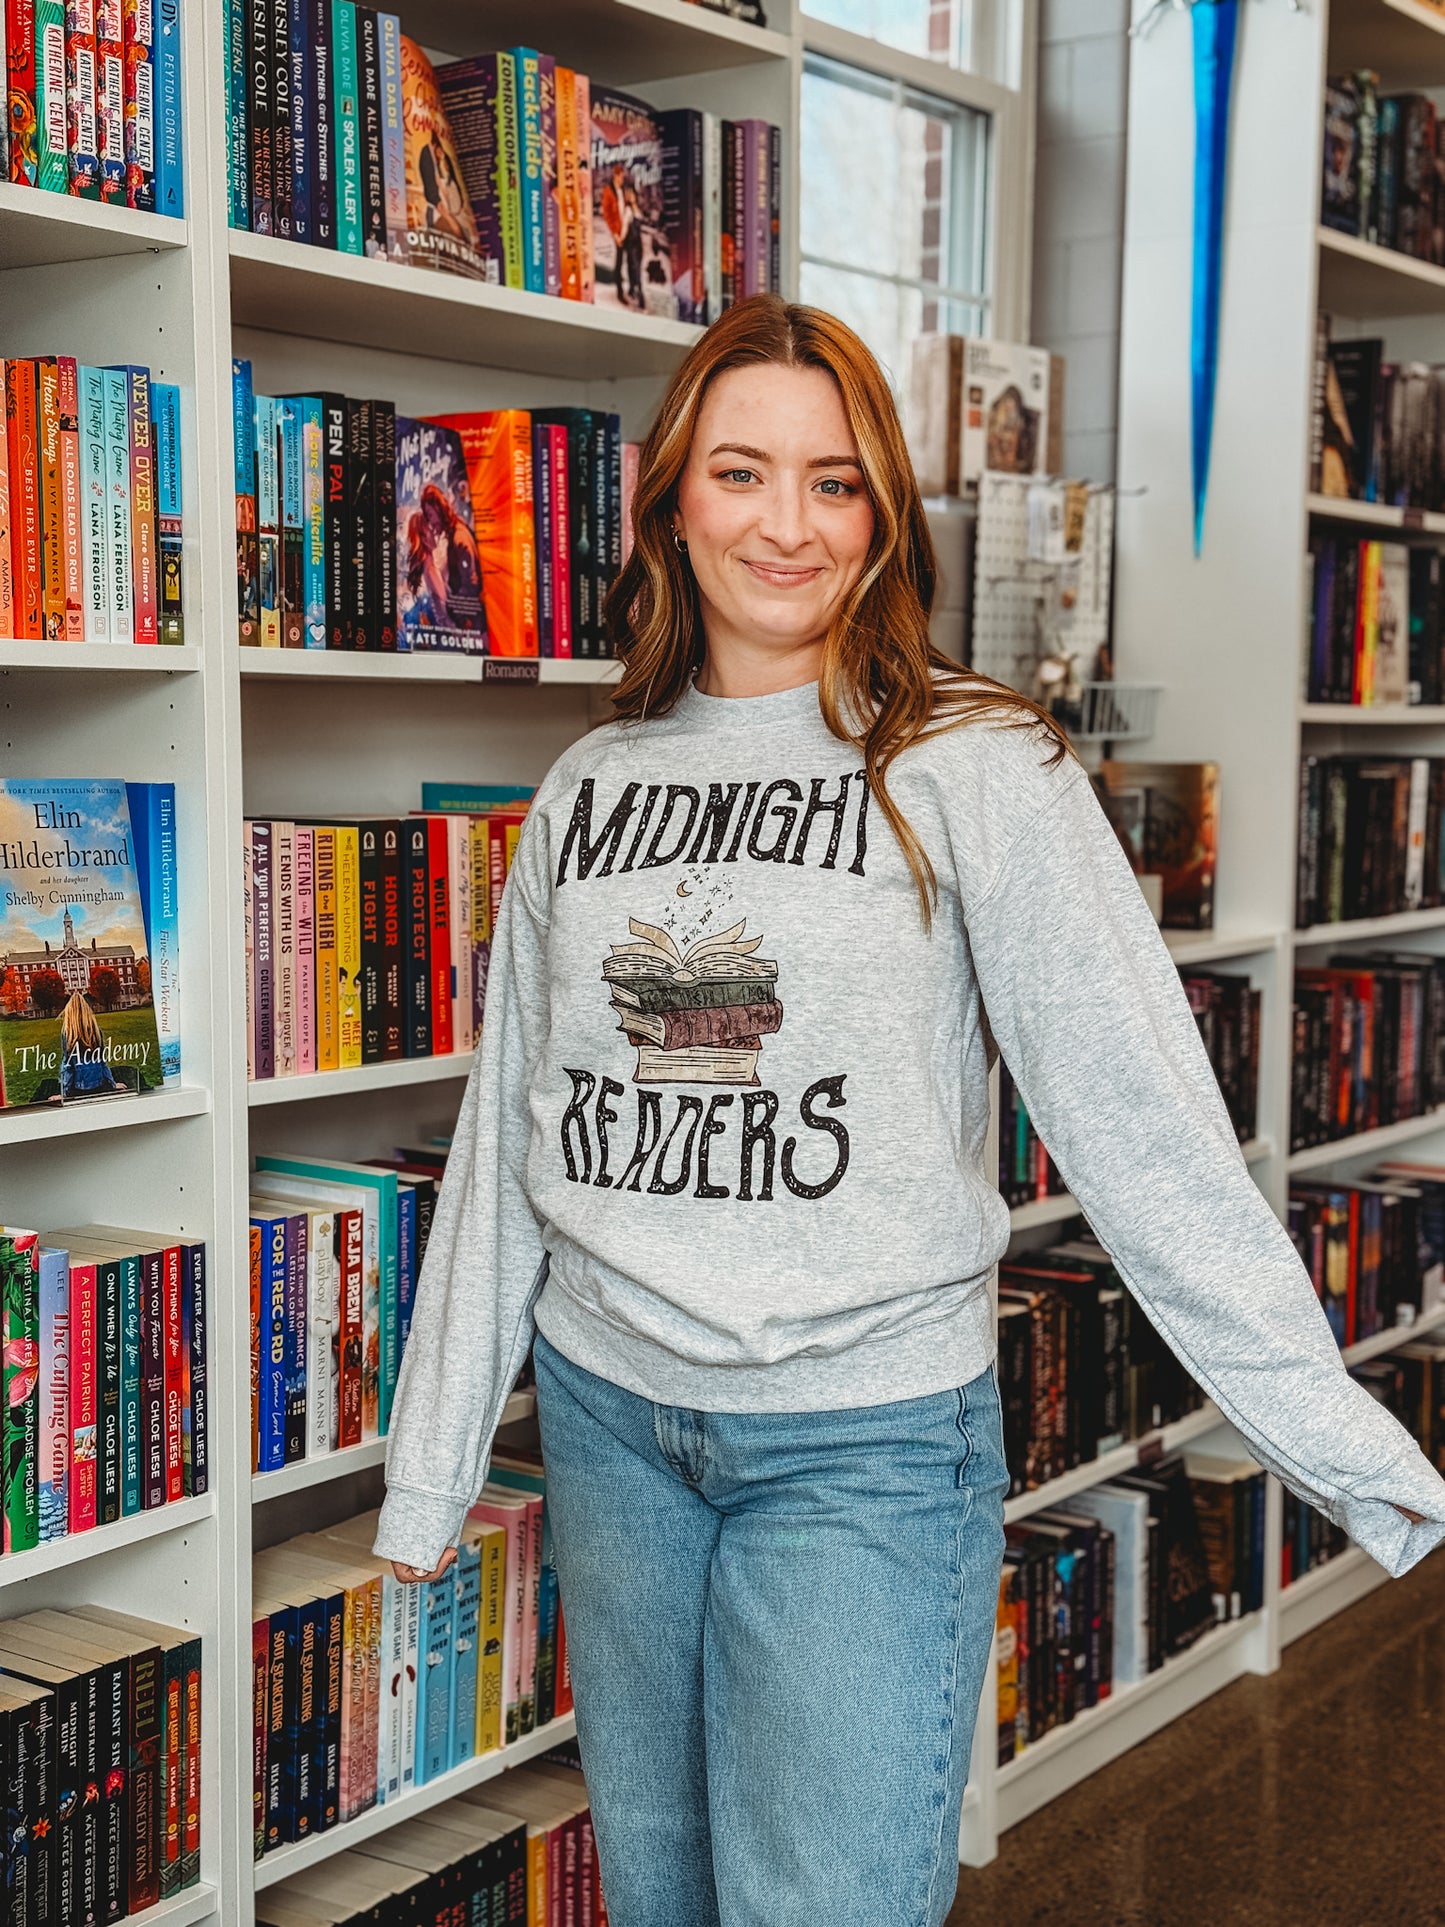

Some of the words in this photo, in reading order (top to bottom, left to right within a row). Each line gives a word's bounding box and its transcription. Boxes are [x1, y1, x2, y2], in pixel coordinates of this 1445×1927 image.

[340, 8, 349, 52] OLIVIA
[363, 19, 373, 63] OLIVIA
[384, 19, 395, 78] OLIVIA
[49, 28, 63, 95] KATHERINE
[79, 52, 92, 112] KATHERINE
[165, 53, 174, 102] PEYTON
[342, 56, 351, 90] DADE
[108, 59, 119, 117] KATHERINE
[138, 64, 149, 122] KATHERINE
[255, 60, 267, 112] COLE
[276, 67, 289, 118] COLE
[366, 67, 376, 101] DADE
[367, 106, 376, 132] ALL
[386, 81, 397, 129] DADE
[501, 57, 516, 167] ZOMROMCOM
[523, 57, 541, 180] Backslide
[50, 102, 64, 151] CENTER
[81, 113, 93, 153] CENTER
[109, 119, 120, 158] CENTER
[139, 126, 150, 168] CENTER
[165, 109, 176, 166] CORINNE
[343, 120, 355, 176] SPOILER
[368, 134, 378, 161] THE
[370, 163, 380, 208] FEELS
[565, 150, 575, 191] LAST
[344, 179, 356, 225] ALERT
[566, 225, 576, 261] LIST
[42, 375, 57, 417] Heart
[132, 372, 149, 448] NEVER
[43, 414, 59, 465] Strings
[65, 437, 74, 458] ALL
[329, 408, 343, 457] PEN
[596, 429, 605, 455] THE
[25, 469, 33, 502] BEST
[66, 461, 76, 502] ROADS
[135, 457, 152, 513] OVER
[330, 464, 343, 502] PAL
[557, 473, 566, 511] WITCH
[596, 459, 606, 515] WRONG
[26, 507, 35, 533] HEX
[67, 503, 76, 537] LEAD
[90, 503, 99, 538] LANA
[113, 504, 122, 540] LANA
[141, 522, 149, 553] Clare
[558, 514, 567, 560] ENERGY
[27, 539, 36, 573] EVER
[50, 512, 59, 583] FAIRBANKS
[68, 538, 76, 556] TO
[596, 518, 606, 566] HEART
[69, 559, 78, 593] ROME
[92, 544, 101, 611] FERGUSON
[114, 545, 124, 612] FERGUSON
[141, 557, 149, 604] Gilmore
[441, 634, 484, 651] GOLDEN
[486, 662, 539, 680] Romance
[32, 801, 82, 829] Elin
[161, 798, 171, 833] Elin
[556, 768, 881, 888] MIDNIGHT
[258, 843, 268, 864] ALL
[280, 838, 291, 851] IT
[298, 833, 311, 897] FREEING
[318, 834, 333, 892] RIDING
[473, 839, 482, 880] HELENA
[64, 875, 89, 885] daughter
[161, 836, 173, 919] Hilderbrand
[258, 867, 268, 898] YOUR
[281, 854, 291, 891] ENDS
[343, 853, 351, 897] HELENA
[6, 890, 44, 908] Shelby
[49, 888, 124, 906] Cunningham
[281, 896, 292, 931] WITH
[364, 881, 377, 943] FIGHT
[385, 876, 398, 947] HONOR
[412, 868, 426, 961] PROTECT
[259, 902, 269, 961] PERFECTS
[282, 935, 292, 954] US
[299, 917, 312, 955] WILD
[319, 912, 335, 951] HIGH
[343, 900, 352, 964] HUNTING
[261, 969, 269, 1011] COLLEEN
[283, 967, 291, 1007] COLLEEN
[261, 1014, 270, 1051] HOOVER
[283, 1011, 291, 1049] HOOVER
[15, 1044, 57, 1073] The
[66, 1036, 151, 1067] Academy
[558, 1067, 850, 1201] READERS
[272, 1223, 285, 1265] FOR
[297, 1228, 306, 1271] KILLER
[347, 1218, 361, 1268] DEJA
[400, 1216, 410, 1270] Academic
[24, 1248, 32, 1316] CHRISTINA
[82, 1276, 90, 1286] A
[106, 1273, 115, 1301] ONLY
[127, 1262, 136, 1310] ALWAYS
[151, 1261, 159, 1289] WITH
[169, 1252, 179, 1320] EVERYTHING
[194, 1252, 202, 1281] EVER
[386, 1267, 394, 1304] LITTLE
[151, 1292, 160, 1315] YOU
[194, 1283, 202, 1315] AFTER
[346, 1273, 361, 1324] BREW
[400, 1273, 409, 1304] Affair
[24, 1318, 32, 1368] LAUREN
[82, 1291, 91, 1357] PERFECT
[107, 1311, 115, 1339] WHEN
[295, 1311, 305, 1368] ROMANCE
[318, 1336, 326, 1381] MARNI
[386, 1334, 394, 1386] FAMILIAR
[82, 1363, 91, 1422] PAIRING
[169, 1390, 178, 1432] CHLOE
[196, 1389, 204, 1431] CHLOE
[317, 1388, 325, 1429] MANN
[25, 1400, 34, 1460] PARADISE
[106, 1414, 115, 1450] CHLOE
[128, 1401, 136, 1438] CHLOE
[151, 1400, 160, 1441] CHLOE
[128, 1441, 137, 1480] LIESE
[151, 1445, 160, 1479] LIESE
[169, 1435, 179, 1469] LIESE
[196, 1434, 204, 1467] LIESE
[25, 1462, 35, 1516] PROBLEM
[106, 1454, 115, 1495] LIESE
[394, 1588, 403, 1606] OFF
[429, 1606, 451, 1623] NEVER
[302, 1622, 314, 1655] SOUL
[330, 1614, 341, 1647] SOUL
[394, 1608, 402, 1633] YOUR
[407, 1621, 417, 1652] GAME
[273, 1630, 285, 1662] SOUL
[392, 1636, 402, 1664] GAME
[430, 1637, 448, 1653] OVER
[88, 1677, 96, 1708] DARK
[135, 1660, 155, 1738] REEL
[271, 1660, 284, 1732] SEARCHING
[300, 1654, 313, 1723] SEARCHING
[328, 1646, 340, 1714] SEARCHING
[112, 1672, 121, 1737] RADIANT
[60, 1723, 69, 1754] RUIN
[68, 1701, 77, 1768] MIDNIGHT
[87, 1711, 96, 1773] RESTRAINT
[111, 1743, 121, 1767] SIN
[108, 1803, 116, 1843] KATEE
[135, 1772, 146, 1841] KENNEDY
[84, 1814, 92, 1854] KATEE
[83, 1858, 92, 1910] ROBERT
[107, 1847, 116, 1897] ROBERT
[135, 1845, 146, 1882] RYAN
[61, 1869, 70, 1922] ROBERT
